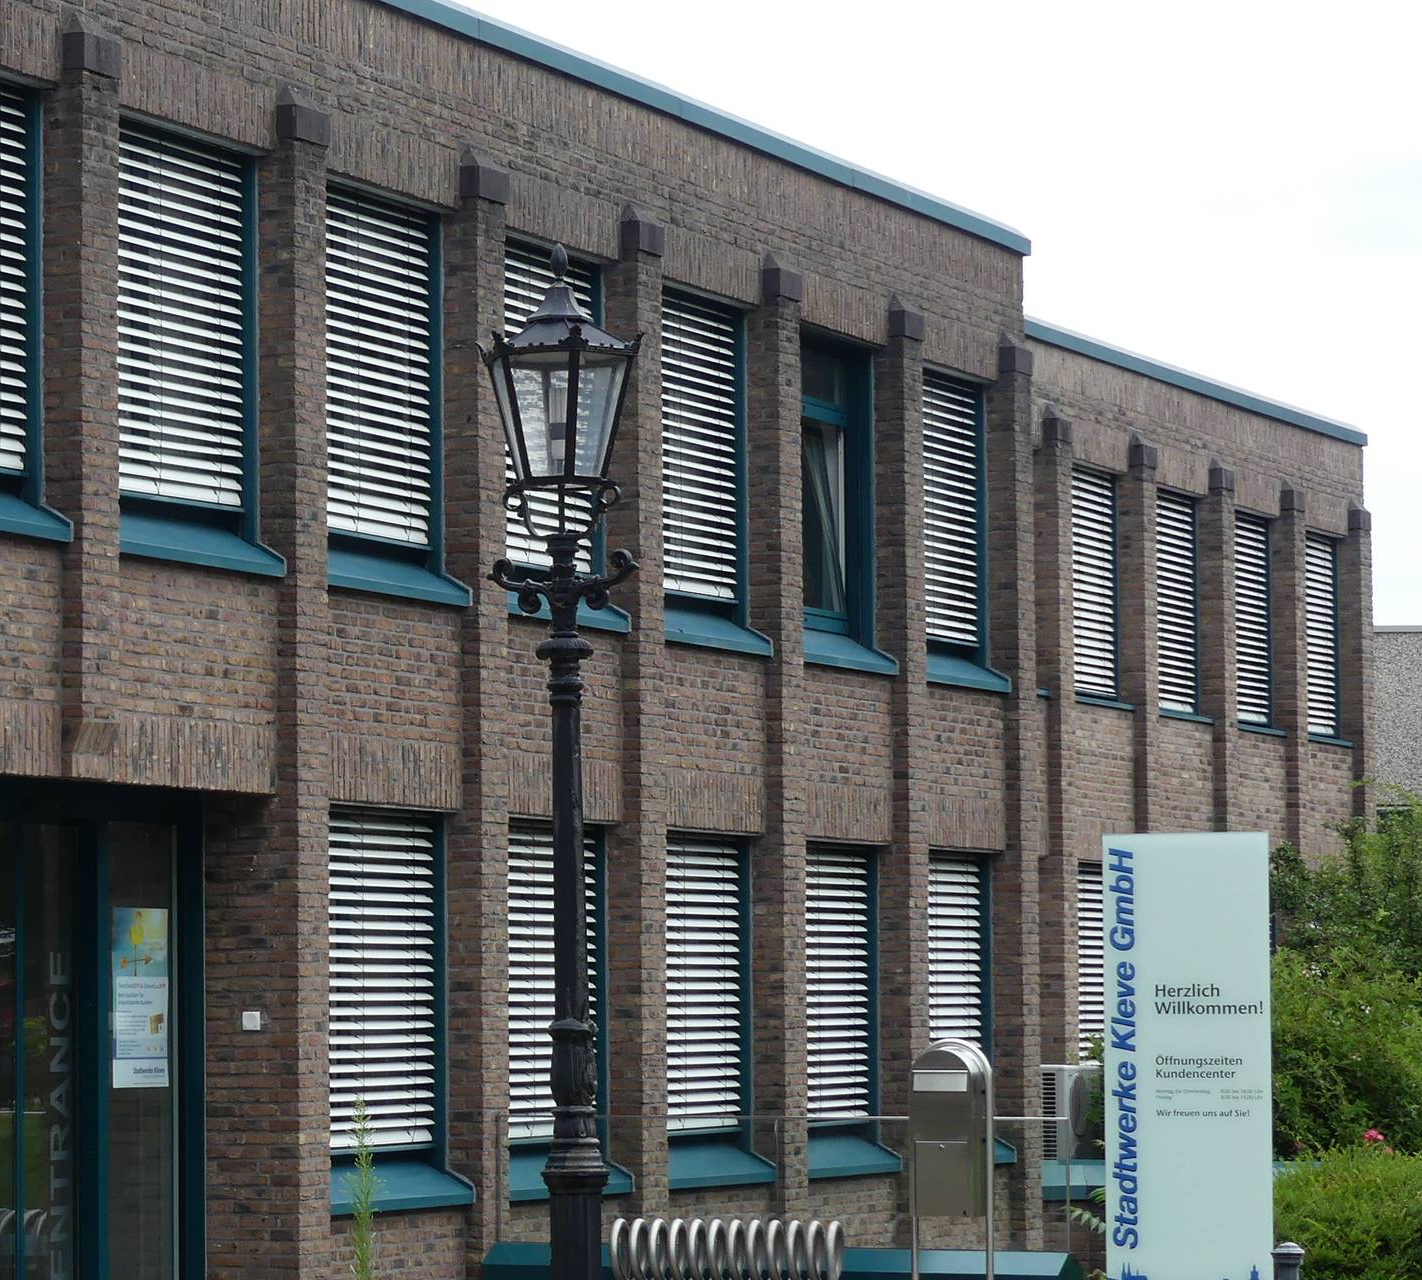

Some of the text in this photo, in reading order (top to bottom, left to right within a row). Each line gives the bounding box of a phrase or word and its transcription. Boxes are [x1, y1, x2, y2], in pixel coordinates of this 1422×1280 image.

[1154, 983, 1221, 998] Herzlich
[1154, 1000, 1264, 1015] Willkommen!
[1108, 847, 1139, 1250] Stadtwerke Kleve GmbH
[1155, 1053, 1243, 1069] Öffnungszeiten
[1155, 1068, 1237, 1079] Kundencenter
[49, 951, 70, 1280] ENTRANCE
[1156, 1109, 1250, 1118] Wir freuen uns auf Sie!
